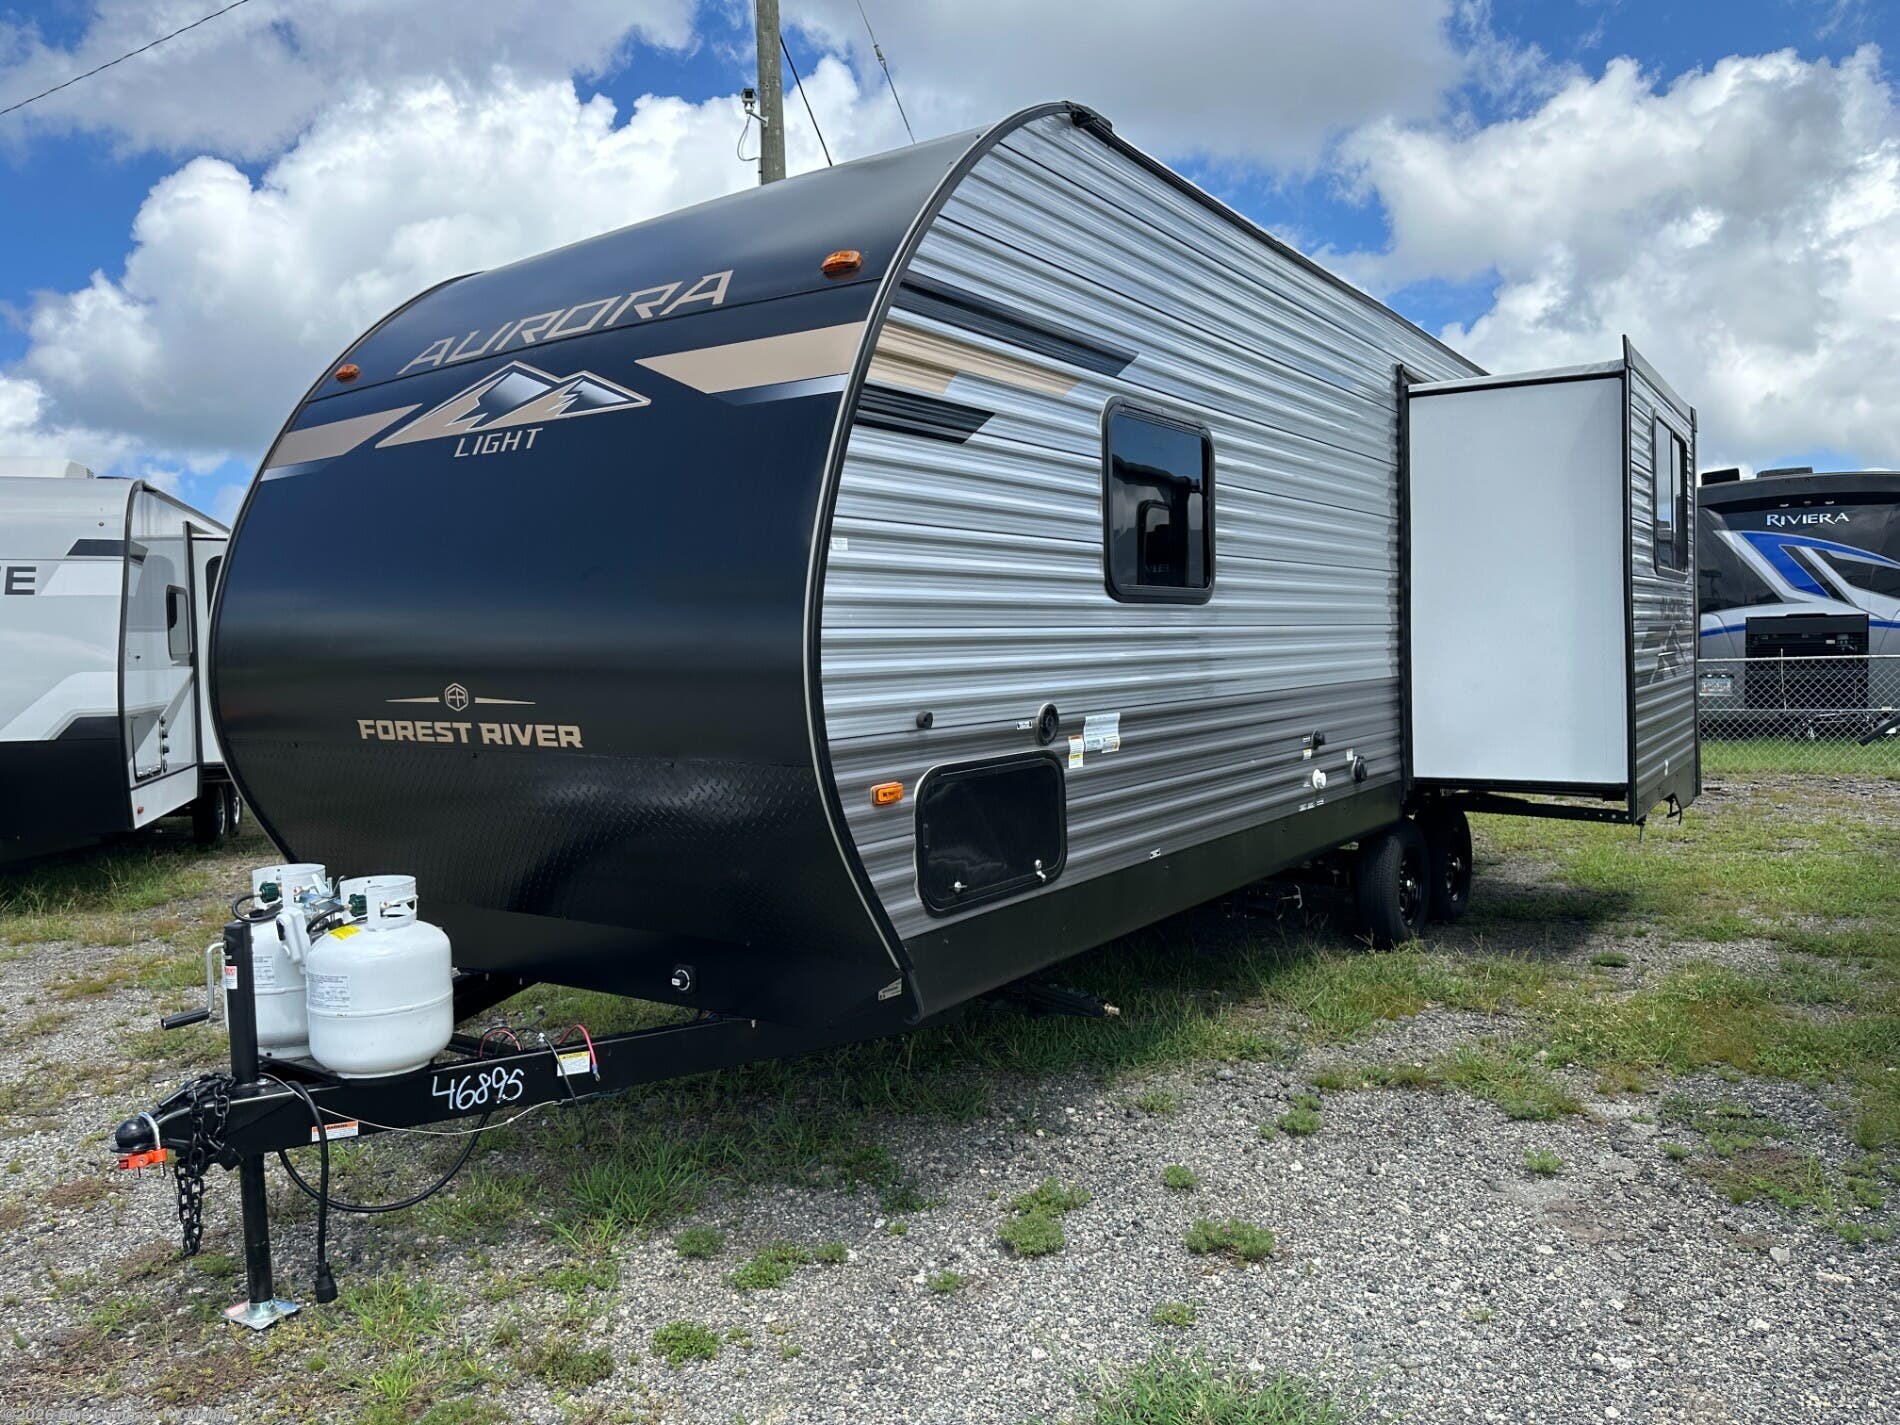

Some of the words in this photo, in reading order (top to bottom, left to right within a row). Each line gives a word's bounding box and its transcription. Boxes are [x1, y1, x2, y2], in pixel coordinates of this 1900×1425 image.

[396, 270, 734, 376] AURORA
[453, 427, 544, 459] LIGHT
[1766, 512, 1850, 528] RIVIERA
[0, 566, 37, 596] E
[357, 719, 472, 744] FOREST
[478, 722, 584, 748] RIVER
[432, 1066, 525, 1111] 46895
